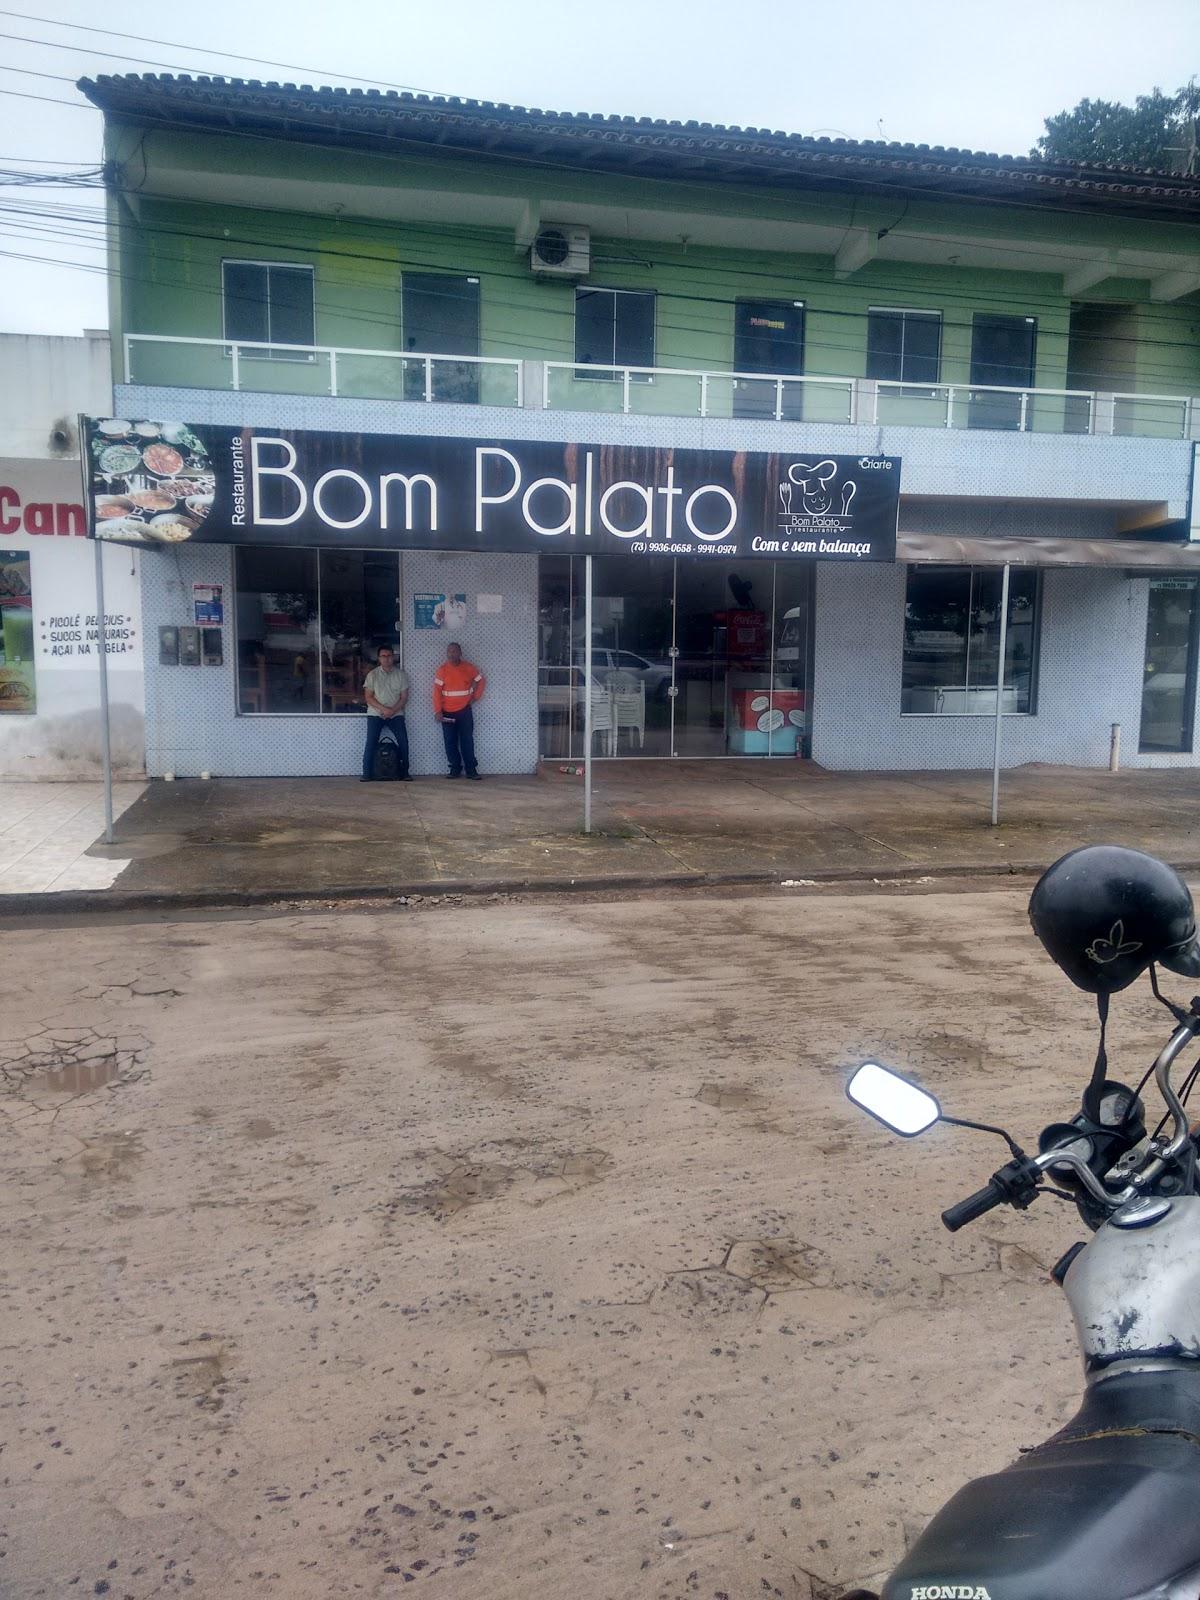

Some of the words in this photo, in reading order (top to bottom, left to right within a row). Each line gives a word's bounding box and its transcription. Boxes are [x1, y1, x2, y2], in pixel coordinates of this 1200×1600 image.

[861, 459, 892, 470] Criarte
[232, 436, 246, 526] Restaurante
[250, 435, 438, 531] Bom
[475, 446, 737, 541] Palato
[791, 515, 810, 526] Bom
[812, 516, 840, 527] Palato
[631, 542, 647, 553] (73)
[649, 542, 692, 553] 9936-0658
[751, 536, 780, 551] Com
[782, 540, 790, 551] e
[791, 540, 816, 552] sem
[819, 539, 871, 557] balança
[49, 614, 80, 628] PICOLÉ
[85, 614, 124, 626] DELCIUS
[50, 631, 82, 642] SUCOS
[86, 629, 129, 640] NAURAIS
[78, 644, 91, 655] NA
[95, 643, 126, 654] TGELA
[911, 1585, 991, 1600] HONDA
